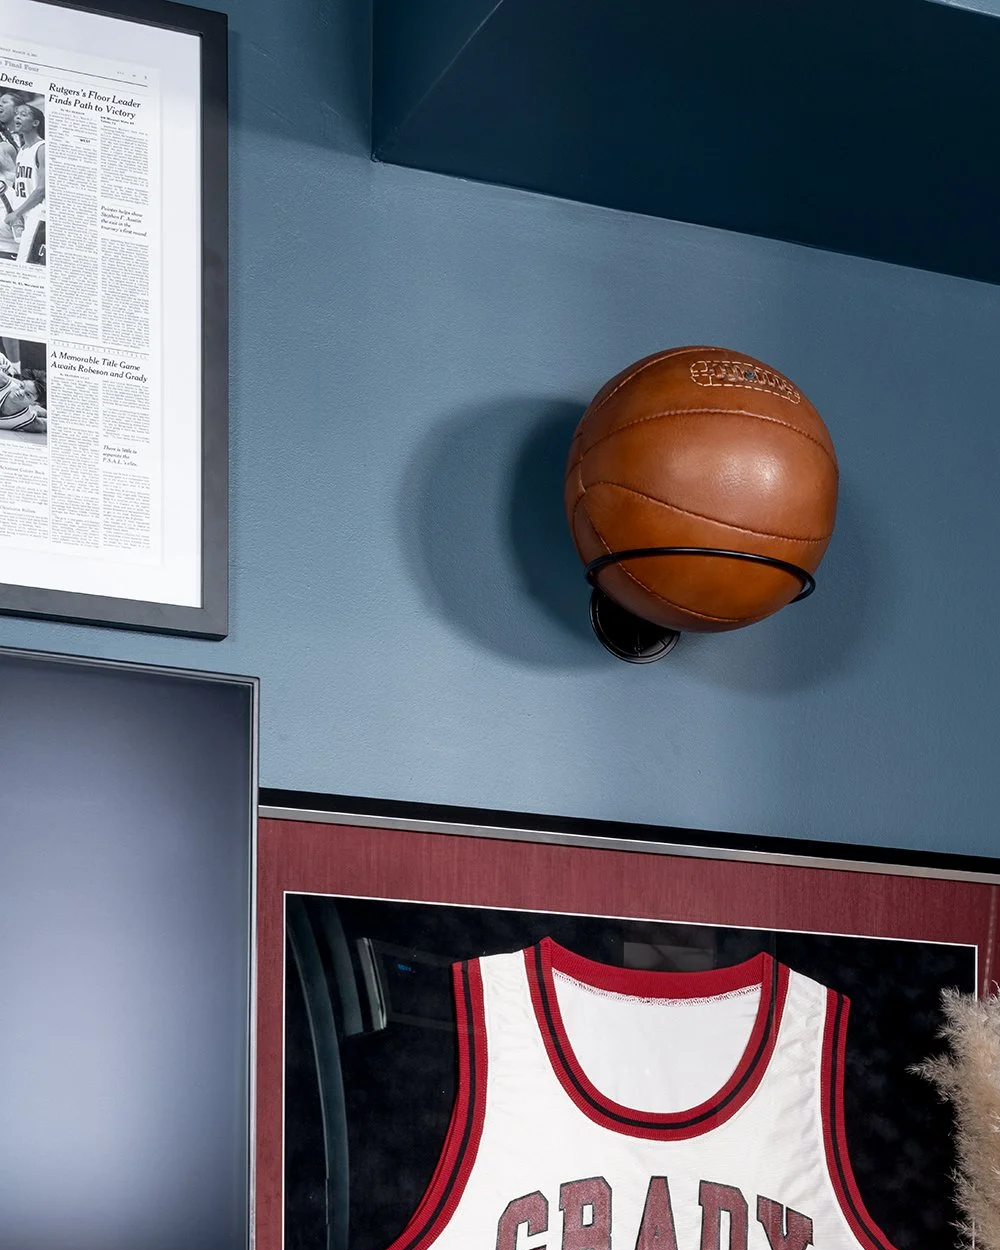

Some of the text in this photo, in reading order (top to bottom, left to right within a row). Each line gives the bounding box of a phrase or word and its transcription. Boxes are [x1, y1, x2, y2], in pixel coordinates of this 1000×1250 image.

[0, 73, 33, 87] Defense
[49, 82, 141, 108] Rutgers's Floor Leader
[49, 94, 71, 106] Finds
[73, 99, 93, 110] Path
[106, 105, 136, 120] Victory
[50, 361, 76, 371] Awaits
[77, 364, 108, 376] Robeson
[125, 371, 148, 383] Grady
[59, 351, 99, 365] Memorable
[101, 358, 118, 368] Title
[119, 361, 140, 371] Game
